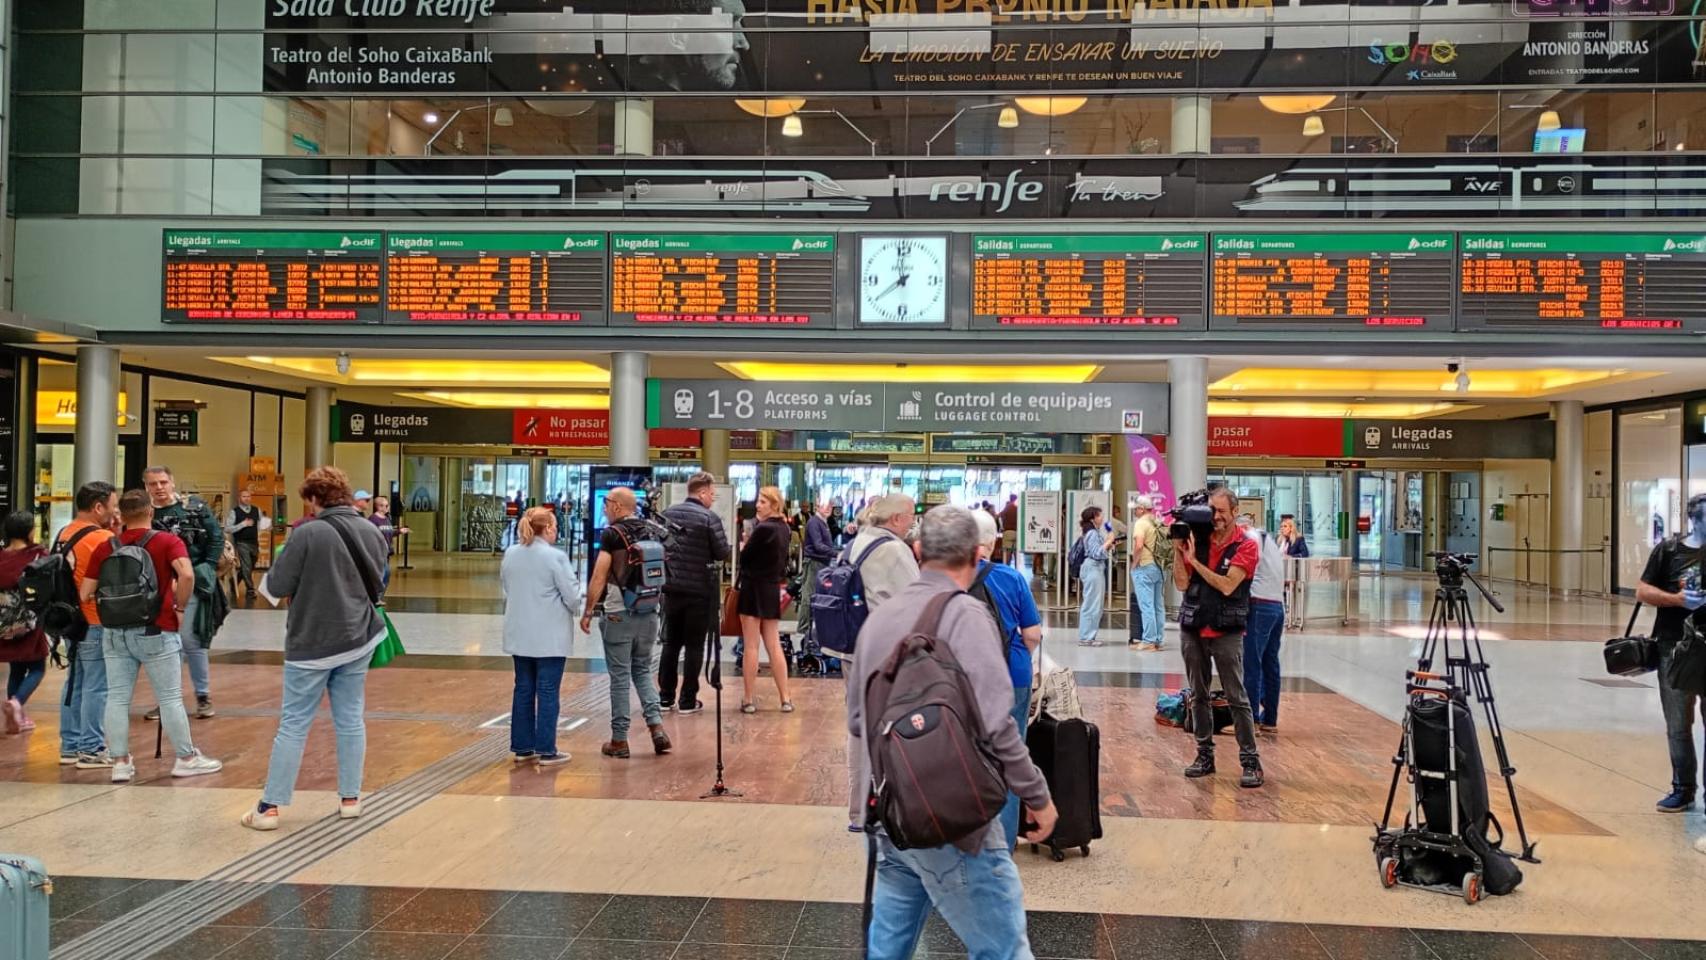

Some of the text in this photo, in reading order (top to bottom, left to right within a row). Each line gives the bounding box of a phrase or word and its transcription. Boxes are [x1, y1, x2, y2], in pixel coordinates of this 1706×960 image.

[273, 0, 496, 23] Sala Club Renfe
[1567, 29, 1607, 39] DIRECCIÓN
[859, 36, 1224, 62] LA EMOCIÓN DE ENSAYAR UN SUEÑO
[1522, 40, 1650, 56] ANTONIO BANDERAS
[272, 47, 494, 63] Teatro del Soho CaixaBank
[308, 67, 456, 85] Antonio Banderas
[893, 72, 1183, 83] TEATRO DEL SOHO CAIXABANK Y RENFE TE DESEAN UN BUEN VIAJE
[714, 181, 751, 196] renfe
[930, 168, 1044, 213] renfe
[1066, 179, 1164, 203] Tu tren
[1463, 180, 1504, 192] AVE
[168, 236, 212, 248] Llegadas
[352, 238, 376, 247] adif
[391, 237, 434, 249] Llegadas
[576, 239, 600, 248] adif
[616, 239, 660, 250] Llegadas
[804, 240, 829, 249] adif
[977, 240, 1014, 249] Salidas
[1217, 239, 1255, 249] Salidas
[1465, 239, 1504, 249] Salidas
[868, 275, 879, 287] 9
[928, 275, 938, 287] 3
[707, 389, 754, 419] 1-8
[764, 390, 872, 406] Acceso a vías
[935, 392, 1113, 412] Control de equipajes
[764, 409, 828, 420] PLATFORMS
[934, 411, 1042, 422] LUGGAGE CONTROL
[373, 413, 429, 430] Llegadas
[549, 416, 607, 433] No pasar
[374, 428, 409, 437] ARRIVALS
[549, 432, 609, 440] NO TRESPASSING
[1213, 426, 1252, 438] pasar
[1388, 426, 1451, 444] Llegadas
[1390, 442, 1429, 450] ARRIVALS
